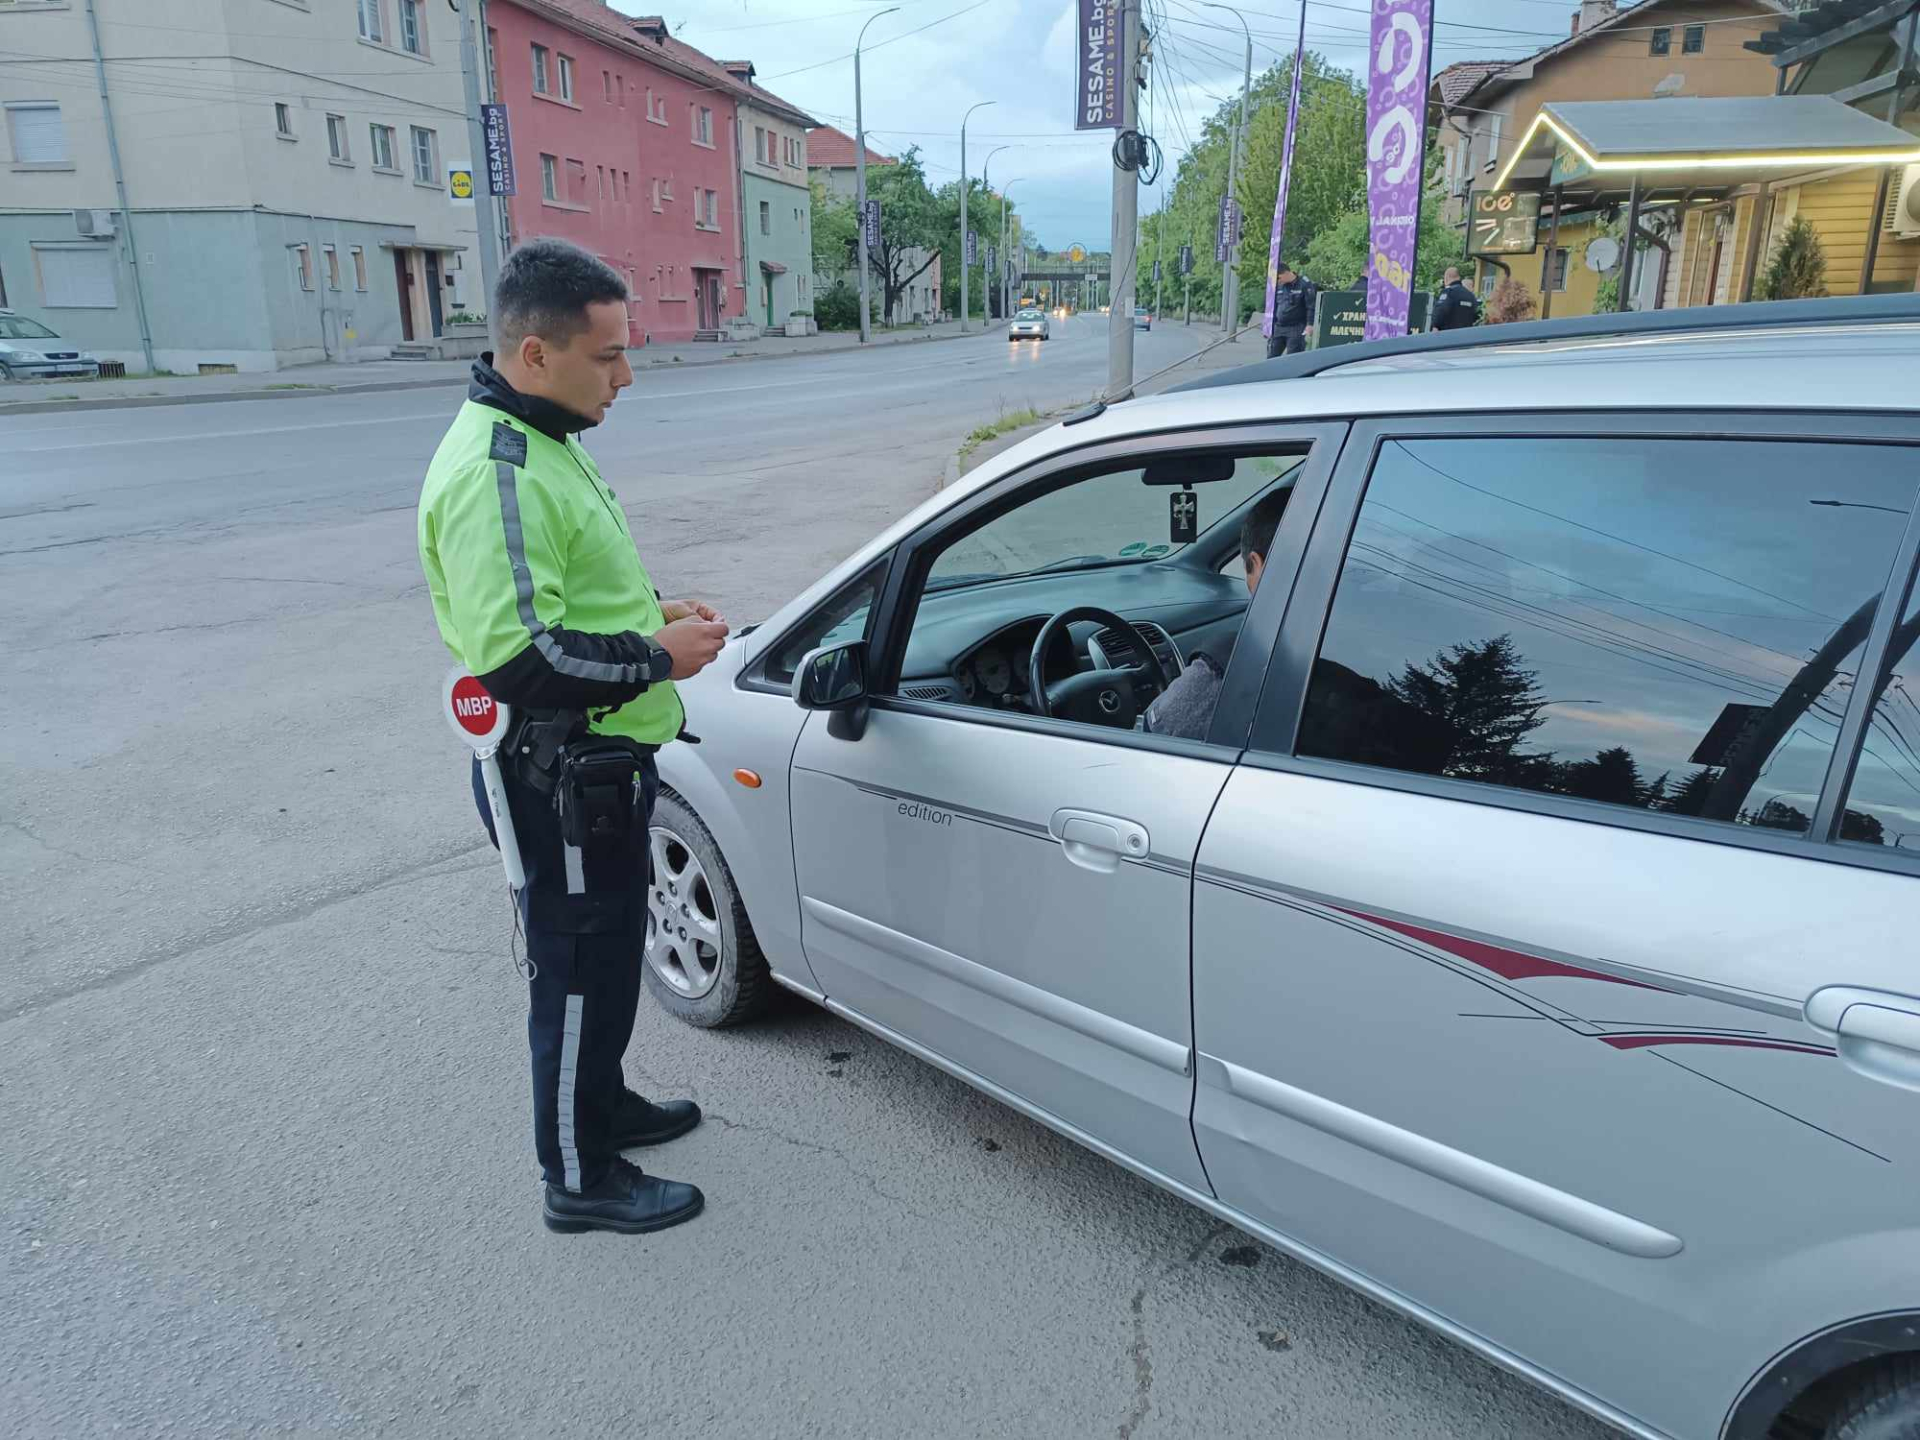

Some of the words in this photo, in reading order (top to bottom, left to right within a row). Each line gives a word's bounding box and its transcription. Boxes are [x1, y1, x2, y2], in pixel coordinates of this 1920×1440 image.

[1105, 67, 1115, 119] CASINO
[488, 108, 504, 192] SESAME.bg
[1342, 311, 1367, 322] ХРАН
[898, 803, 952, 826] edition
